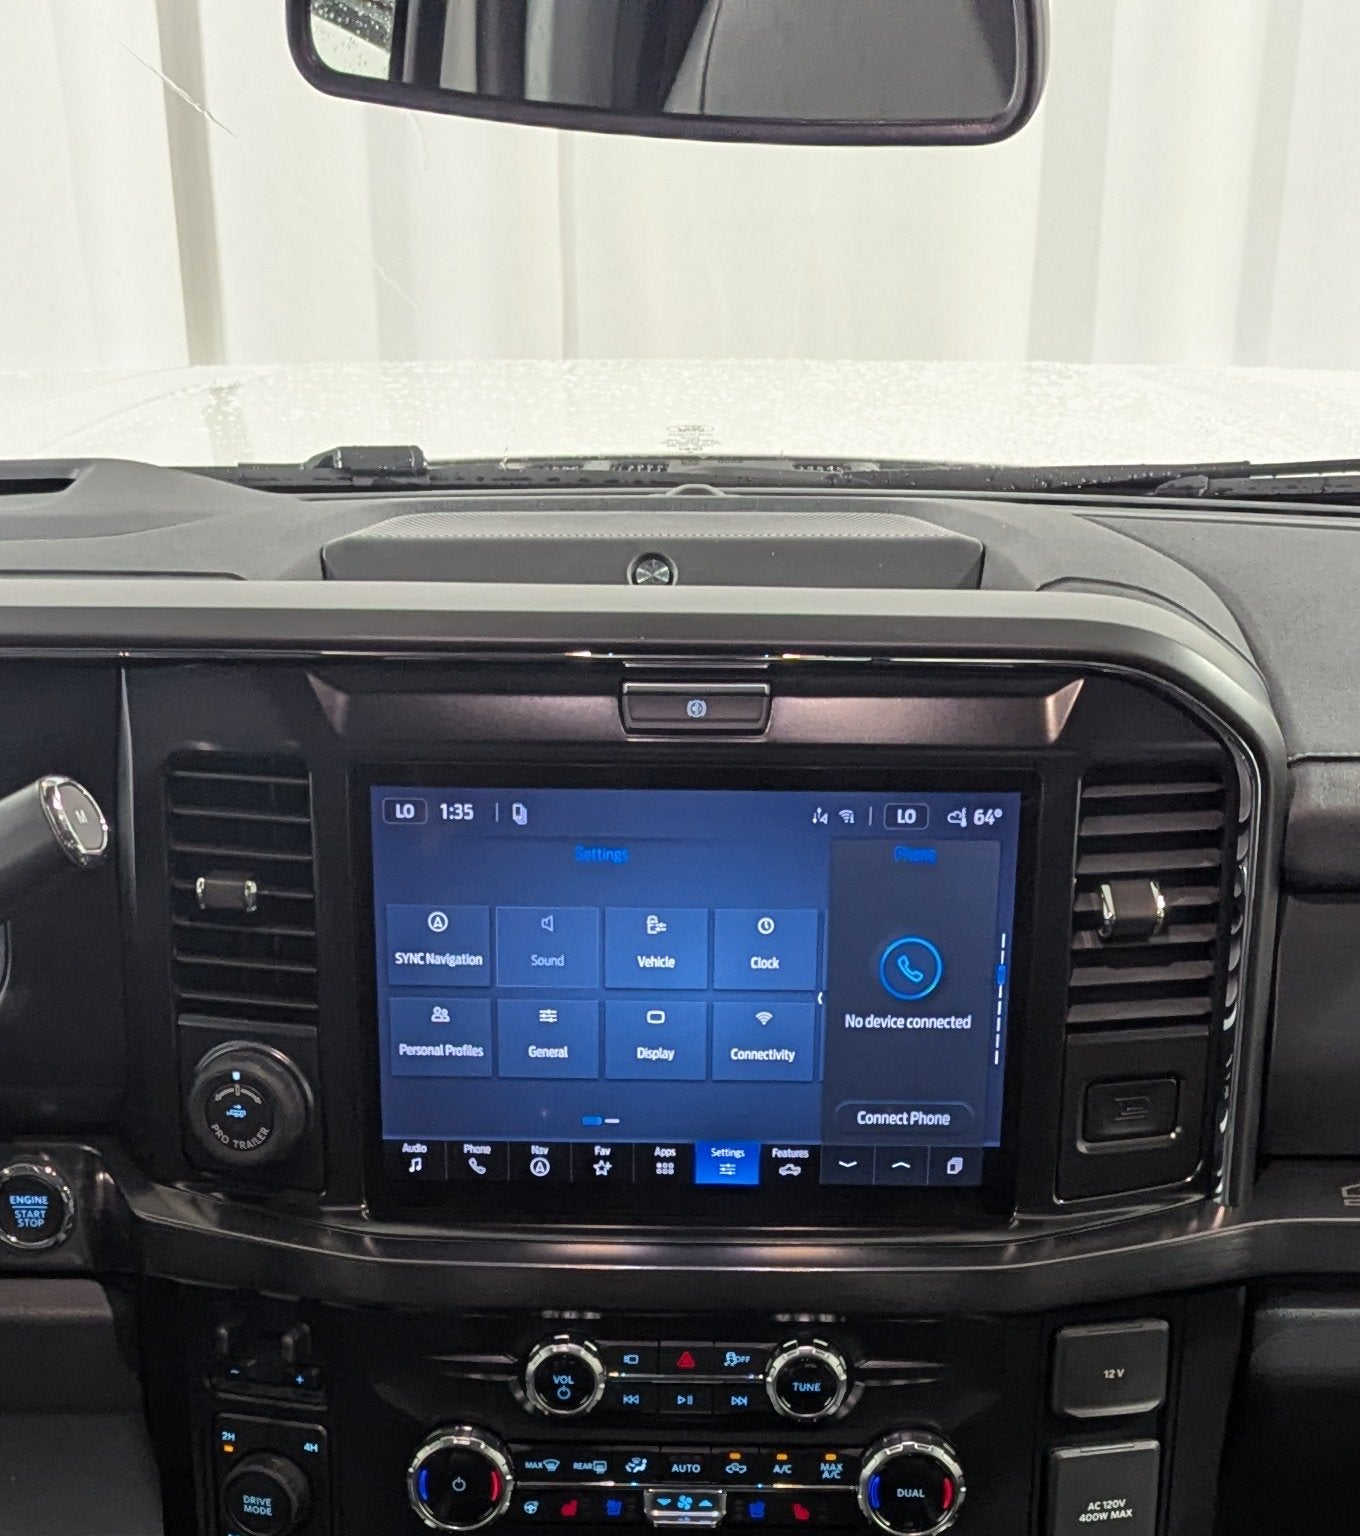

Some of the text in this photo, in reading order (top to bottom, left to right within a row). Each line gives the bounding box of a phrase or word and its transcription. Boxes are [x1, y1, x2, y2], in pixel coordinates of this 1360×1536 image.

[395, 803, 415, 819] LO
[440, 803, 474, 820] 1:35
[896, 808, 917, 824] LO
[973, 808, 1003, 826] 64°
[574, 846, 629, 863] Settings
[395, 952, 484, 967] SYNC Navigation
[531, 954, 565, 967] Sound
[637, 956, 675, 968] Vehicle
[750, 956, 780, 970] Clock
[845, 1014, 972, 1029] No device connected
[399, 1043, 484, 1058] Personal Profiles
[528, 1046, 568, 1059] General
[636, 1047, 675, 1061] Display
[730, 1048, 795, 1063] Connectivity
[857, 1111, 951, 1126] Connect Phone
[211, 1124, 271, 1150] PRO TRAILER
[401, 1143, 428, 1154] Audio
[463, 1143, 491, 1155] Phone
[530, 1145, 549, 1155] Nav
[594, 1145, 611, 1157] Fav
[654, 1146, 677, 1158] Apps
[710, 1146, 746, 1159] Settings
[772, 1147, 810, 1159] Features
[9, 1195, 49, 1205] ENGINE
[14, 1209, 46, 1219] START
[17, 1218, 45, 1228] STOP
[735, 1355, 751, 1364] OFF
[553, 1374, 575, 1385] VOL
[792, 1382, 821, 1393] TUNE
[221, 1431, 236, 1441] 2H
[303, 1442, 319, 1453] 4H
[524, 1461, 543, 1470] MAX
[572, 1461, 593, 1470] REAR
[671, 1463, 701, 1473] AUTO
[772, 1463, 792, 1474] A/C
[820, 1462, 843, 1472] MAX
[822, 1470, 842, 1480] A/C
[896, 1487, 926, 1498] DUAL
[243, 1494, 272, 1507] DRIVE
[1087, 1499, 1127, 1511] AC 120V
[243, 1504, 273, 1516] MODE
[1078, 1509, 1133, 1523] 400W MAX
